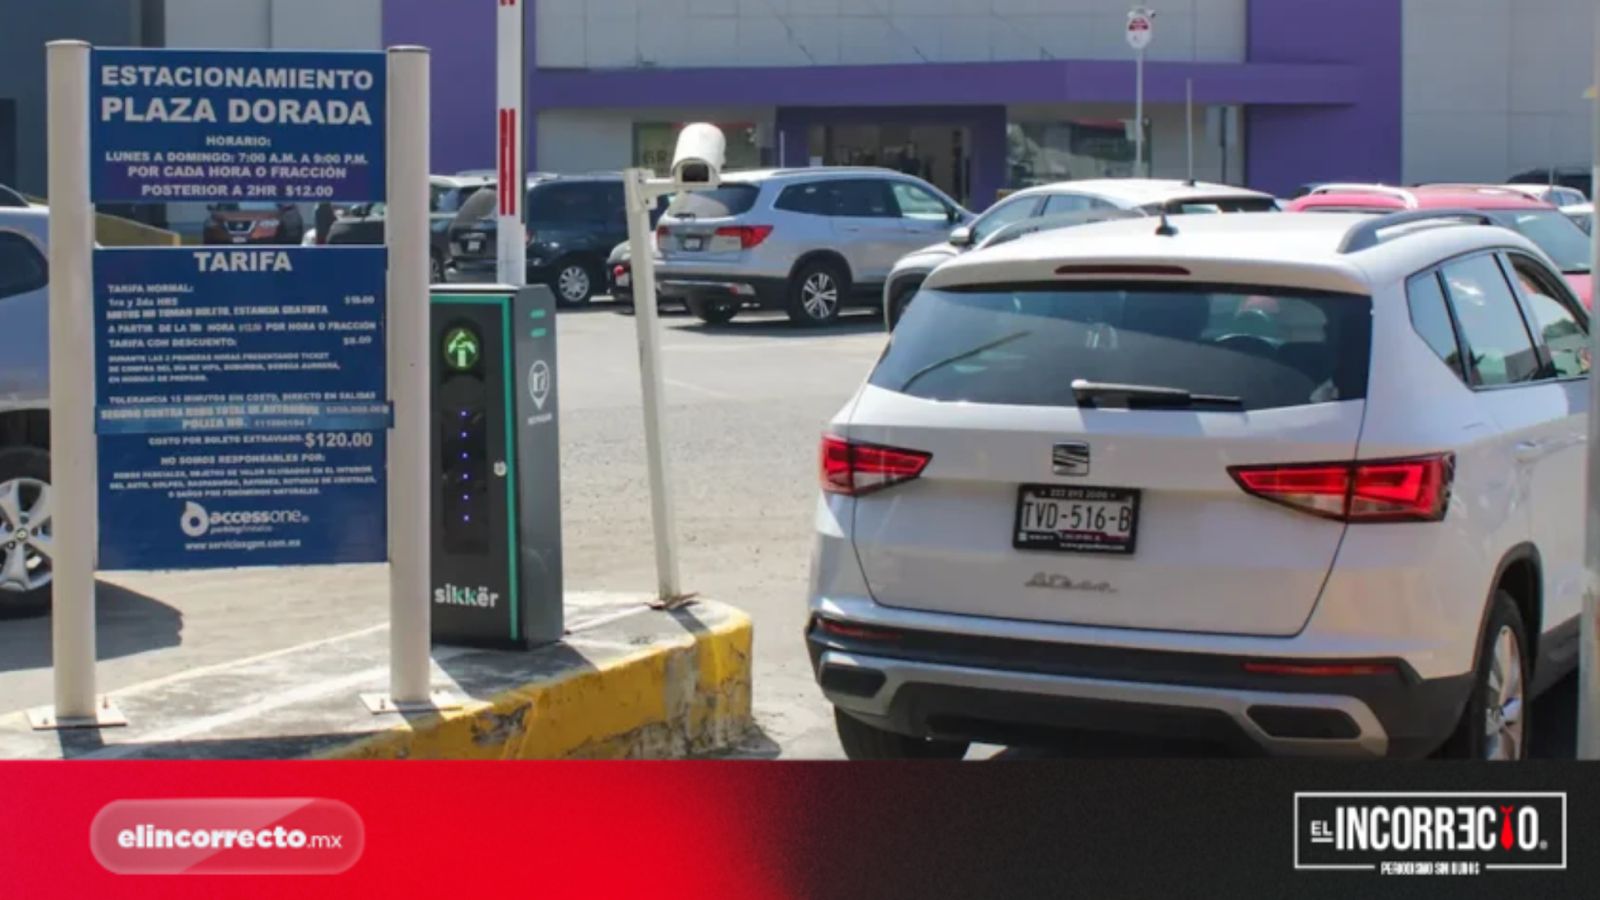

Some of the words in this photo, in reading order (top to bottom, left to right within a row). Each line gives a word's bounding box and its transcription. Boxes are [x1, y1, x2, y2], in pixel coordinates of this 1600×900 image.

[101, 65, 374, 90] ESTACIONAMIENTO
[101, 97, 217, 123] PLAZA
[228, 99, 372, 126] DORADA
[206, 135, 272, 147] HORARIO:
[105, 151, 150, 162] LUNES
[154, 152, 163, 163] A
[167, 152, 235, 163] DOMINGO:
[238, 152, 266, 163] 7:00
[269, 152, 297, 164] A.M.
[301, 153, 311, 164] A
[313, 153, 342, 165] 9:00
[345, 154, 369, 165] P.M.
[128, 165, 160, 177] POR
[164, 165, 205, 177] CADA
[208, 166, 251, 178] HORA
[256, 167, 267, 178] O
[271, 165, 347, 179] FRACCIÓN
[141, 184, 228, 197] POSTERIOR
[232, 185, 243, 197] A
[247, 185, 277, 197] 2HR
[285, 185, 334, 197] $12.00
[193, 251, 293, 272] TARIFA
[107, 283, 144, 294] TARIFA
[174, 323, 187, 332] LA
[265, 321, 286, 331] POR
[288, 321, 316, 331] HORA
[108, 338, 145, 349] TARIFA
[146, 338, 170, 348] CON
[148, 435, 181, 446] COSTO
[304, 431, 373, 449] $120.00
[160, 456, 177, 466] NO
[1022, 502, 1133, 532] TVD-516-B
[434, 583, 499, 608] sikkër
